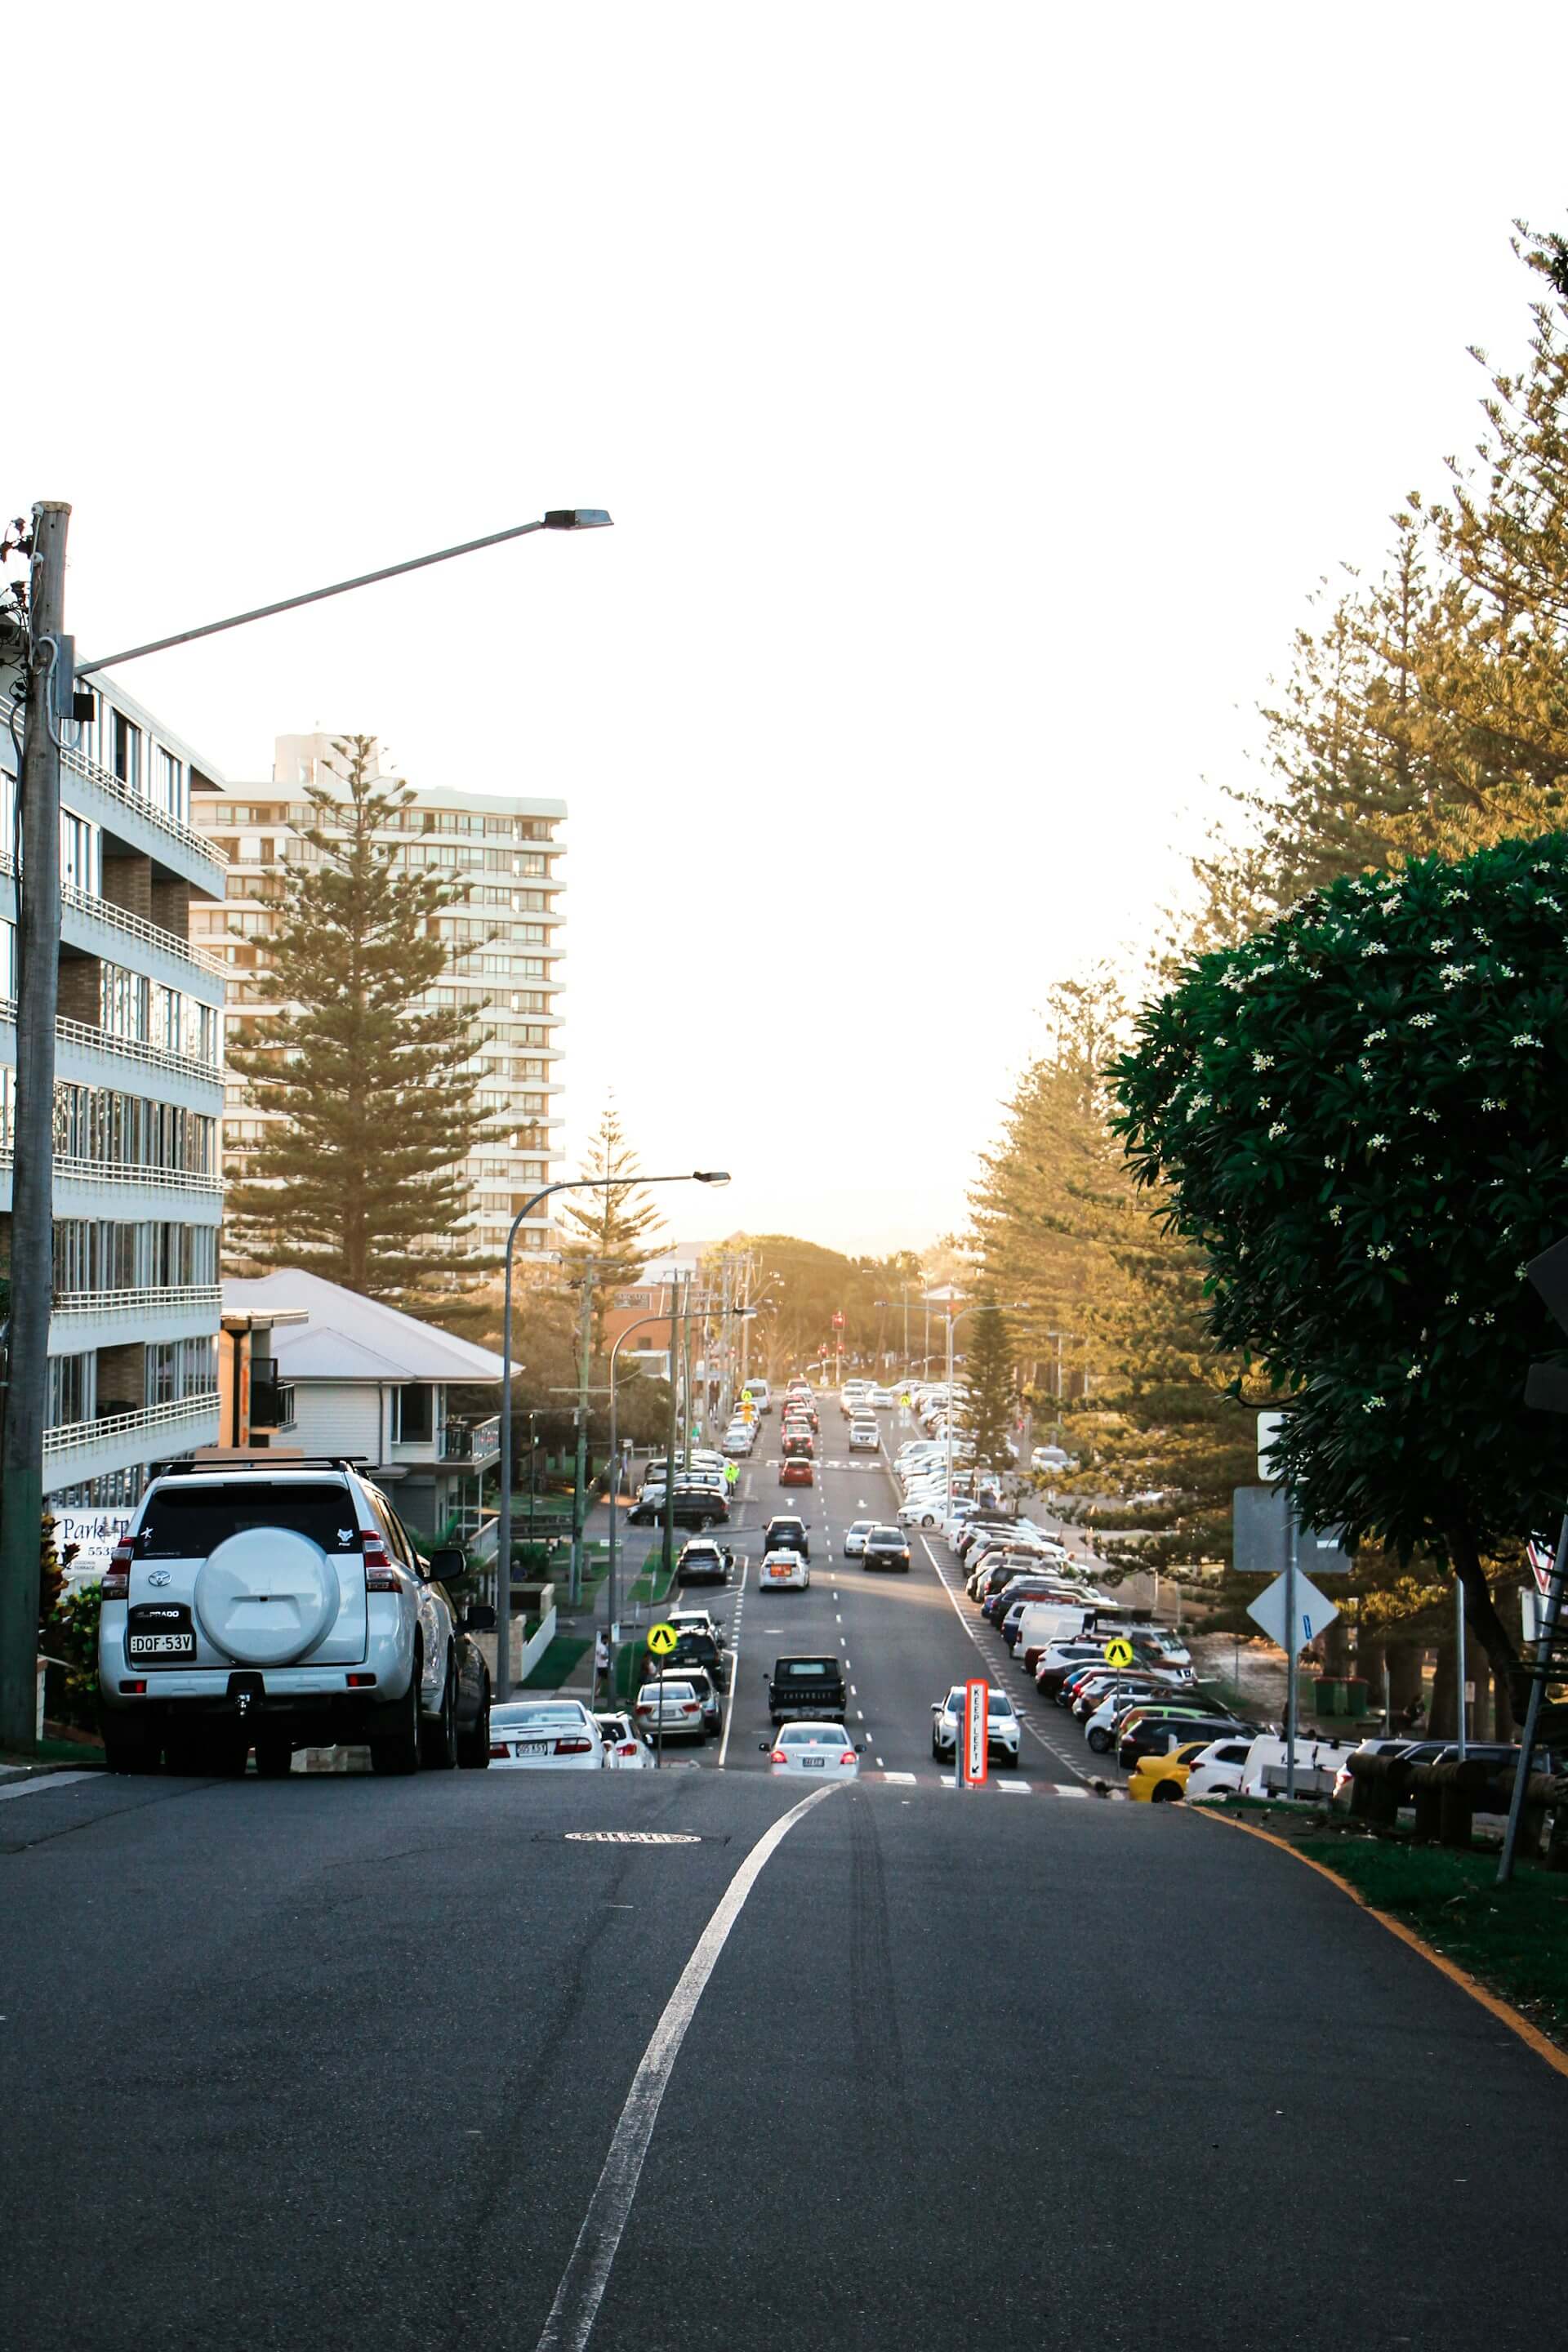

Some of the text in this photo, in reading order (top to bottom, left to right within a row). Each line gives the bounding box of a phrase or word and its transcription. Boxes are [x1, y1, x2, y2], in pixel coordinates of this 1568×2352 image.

[63, 1517, 104, 1540] Park
[88, 1547, 116, 1555] 553
[783, 1691, 831, 1699] CHEVROLET
